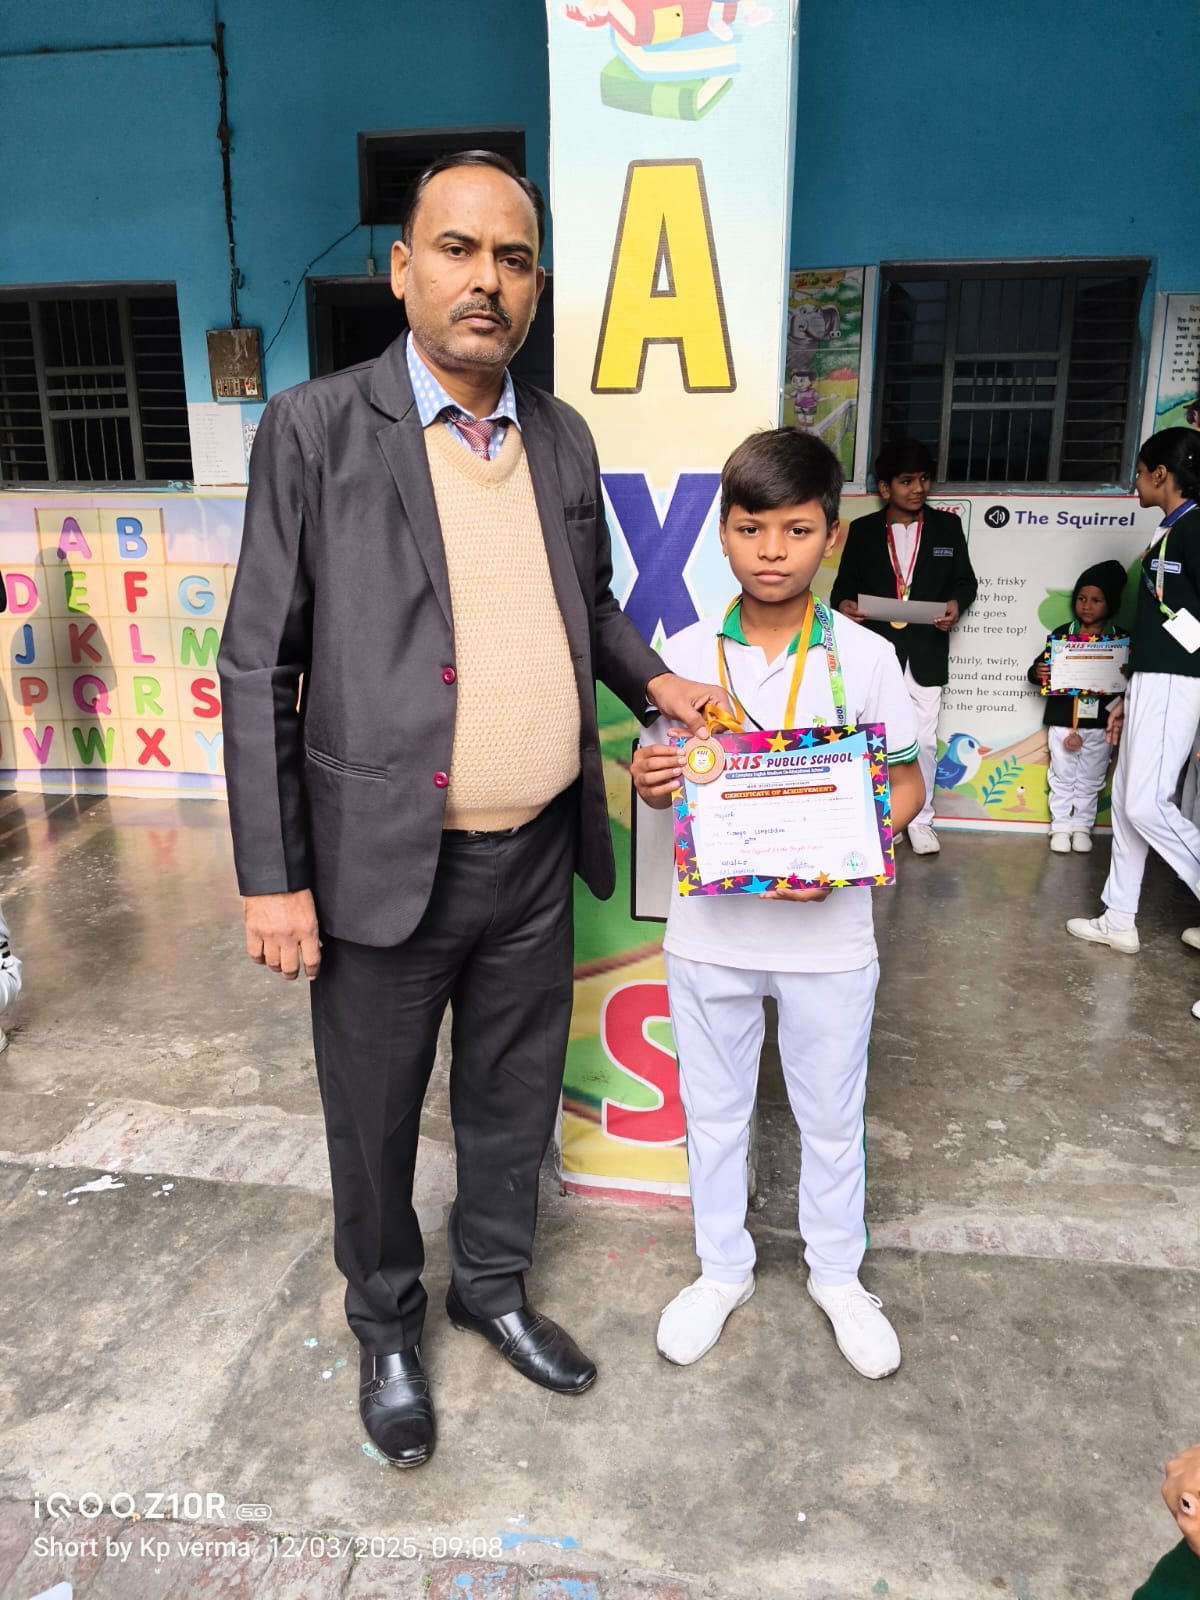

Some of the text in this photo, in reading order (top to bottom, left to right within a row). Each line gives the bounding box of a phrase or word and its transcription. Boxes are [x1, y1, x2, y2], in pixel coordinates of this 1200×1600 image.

[590, 158, 737, 394] A
[1015, 510, 1135, 529] The Squirrel
[57, 516, 148, 559] A B
[600, 472, 724, 648] X
[997, 576, 1026, 588] frisky
[5, 571, 216, 615] D E F G
[967, 609, 1007, 620] he goes
[963, 625, 980, 633] the
[983, 626, 1003, 634] tree
[1006, 626, 1027, 636] top!
[15, 623, 220, 666] J K L M
[987, 657, 1019, 667] twirly,
[948, 672, 978, 681] ound
[981, 672, 1002, 681] and
[20, 674, 221, 718] P Q R S
[943, 687, 973, 695] Down
[976, 688, 990, 696] he
[956, 702, 973, 711] the
[976, 704, 1017, 713] ground.
[23, 725, 223, 771] V W X Y
[766, 756, 807, 769] PUBLIC
[810, 753, 853, 766] SCHOOL
[724, 786, 834, 799] CERTIFICATE OF ACHIEVEMENT
[601, 980, 688, 1146] S
